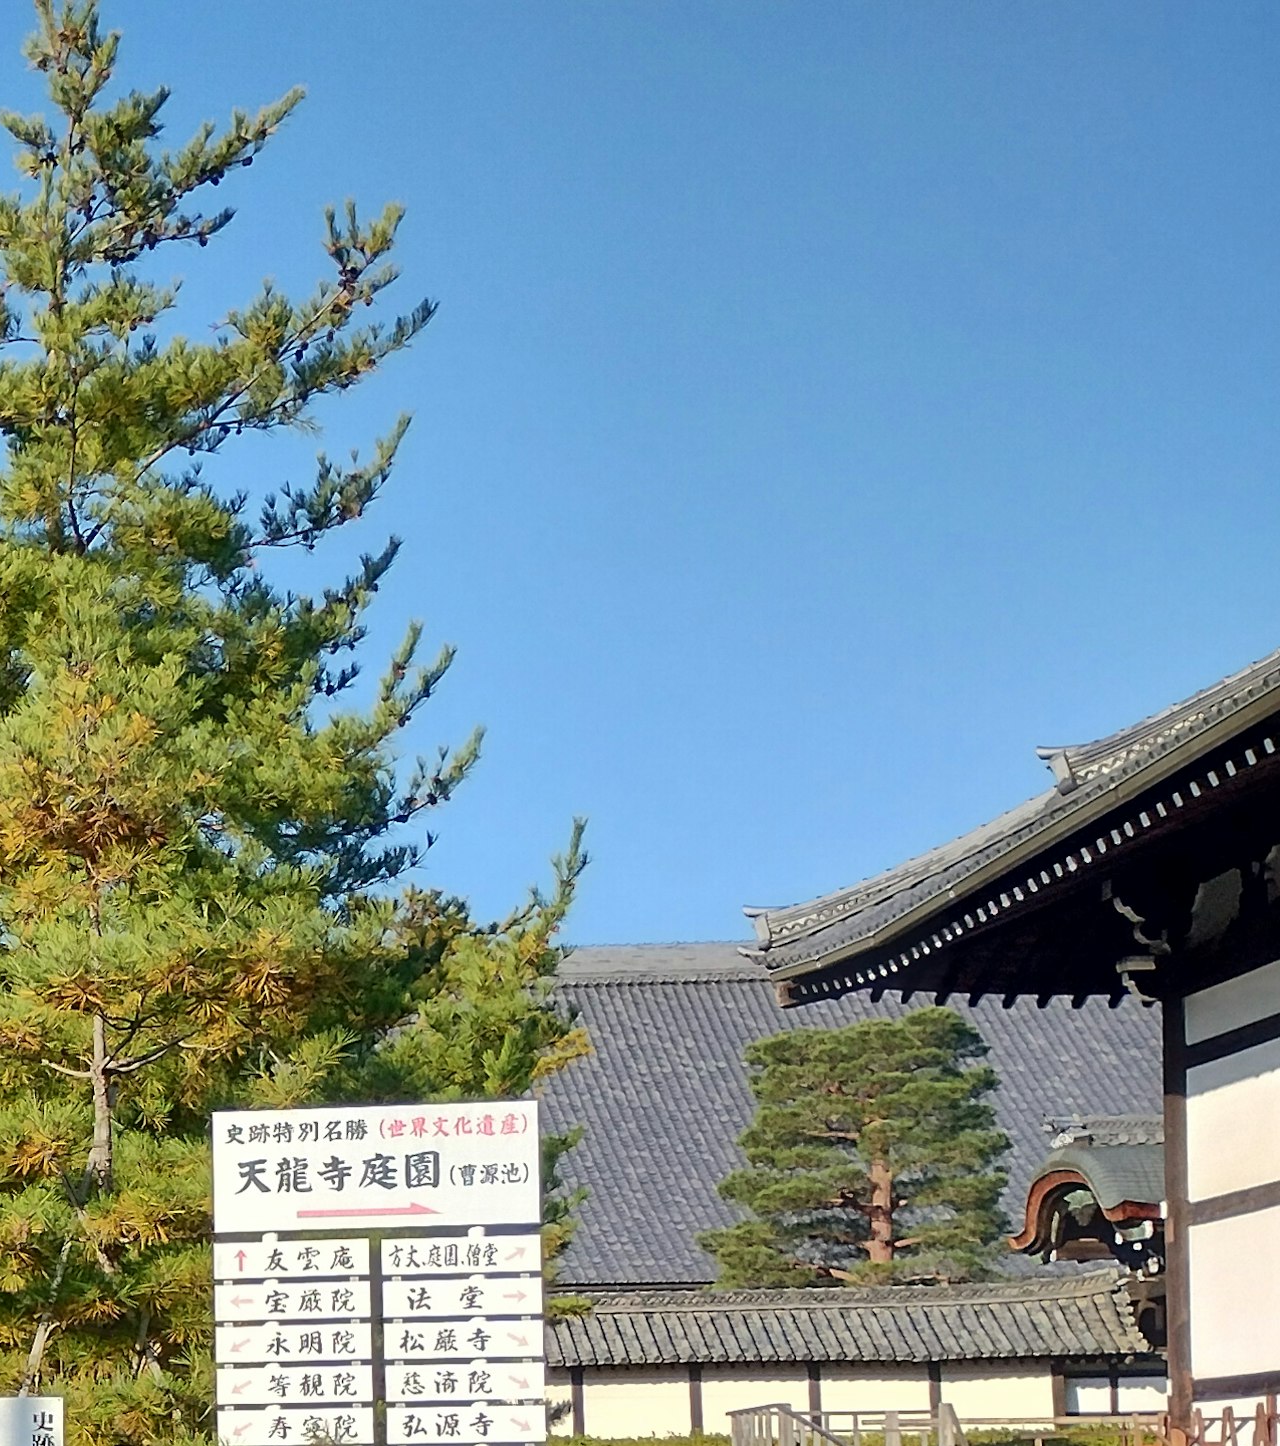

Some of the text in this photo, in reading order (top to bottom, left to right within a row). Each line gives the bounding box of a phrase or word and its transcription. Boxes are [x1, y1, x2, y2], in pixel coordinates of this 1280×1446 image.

[224, 1111, 529, 1145] 史跡特別名勝 （世界文化遺産）
[234, 1150, 530, 1195] 天龍寺庭園 （曹源池）
[265, 1330, 357, 1356] 永明院
[402, 1411, 495, 1438] 弘源寺
